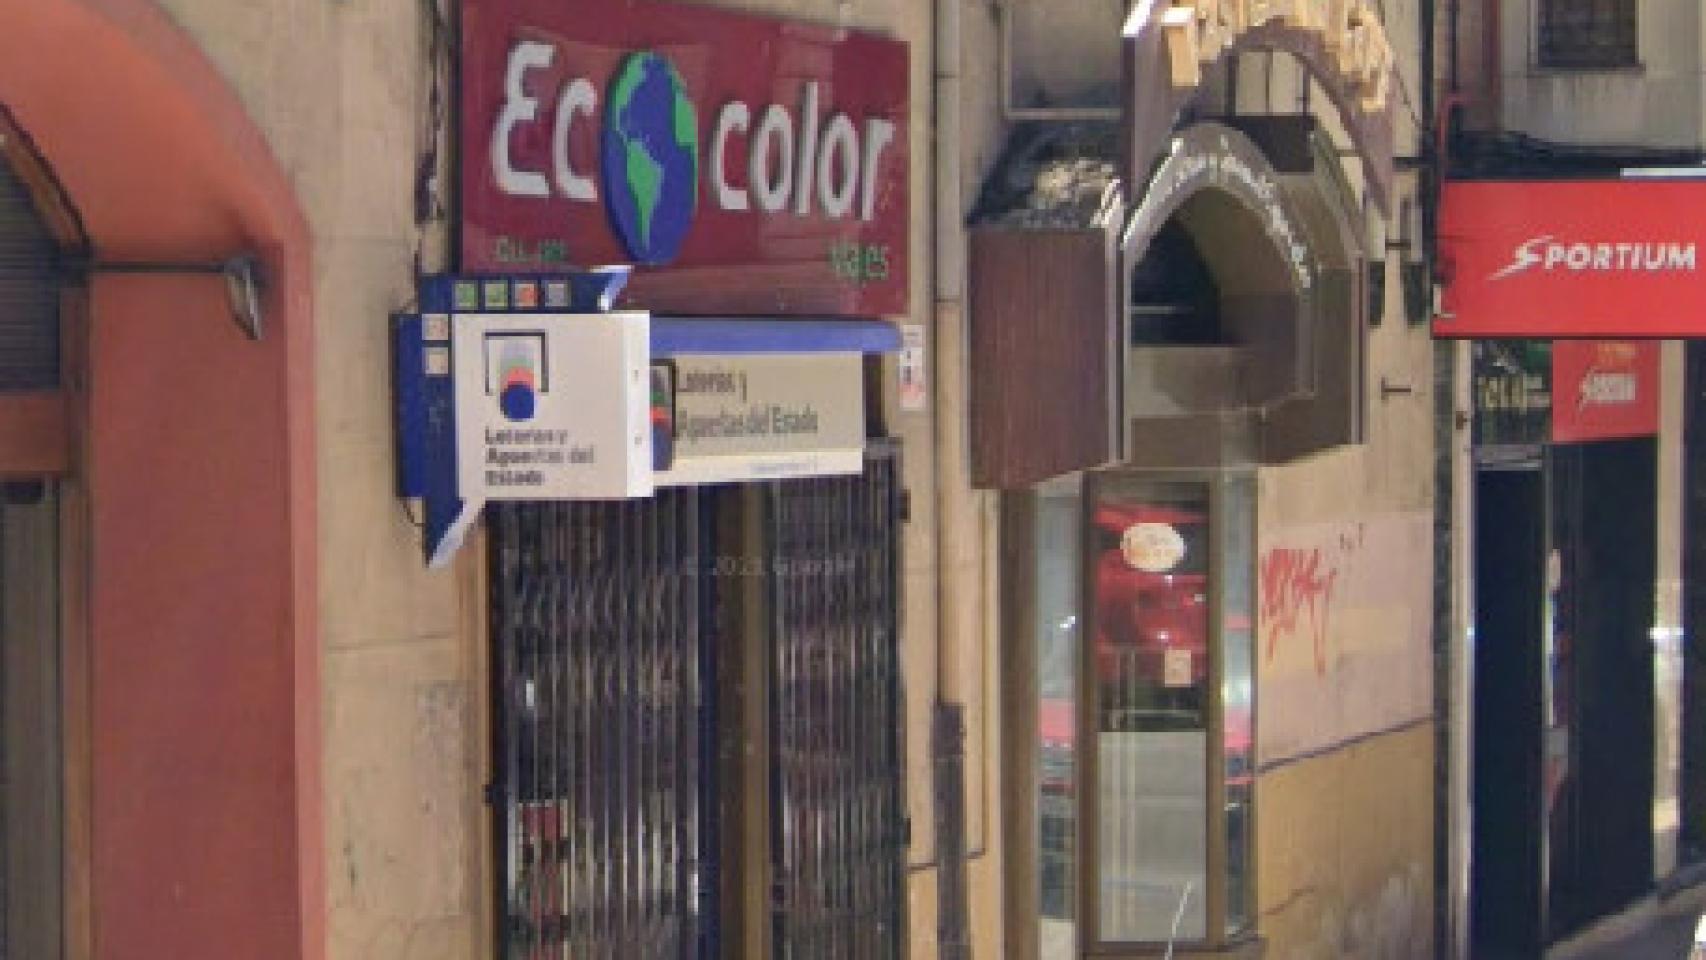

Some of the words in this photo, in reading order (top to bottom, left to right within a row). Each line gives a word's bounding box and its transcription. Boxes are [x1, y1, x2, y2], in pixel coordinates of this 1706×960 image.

[1486, 234, 1697, 281] SPORTIUM
[569, 444, 596, 464] del
[484, 470, 544, 487] Estado
